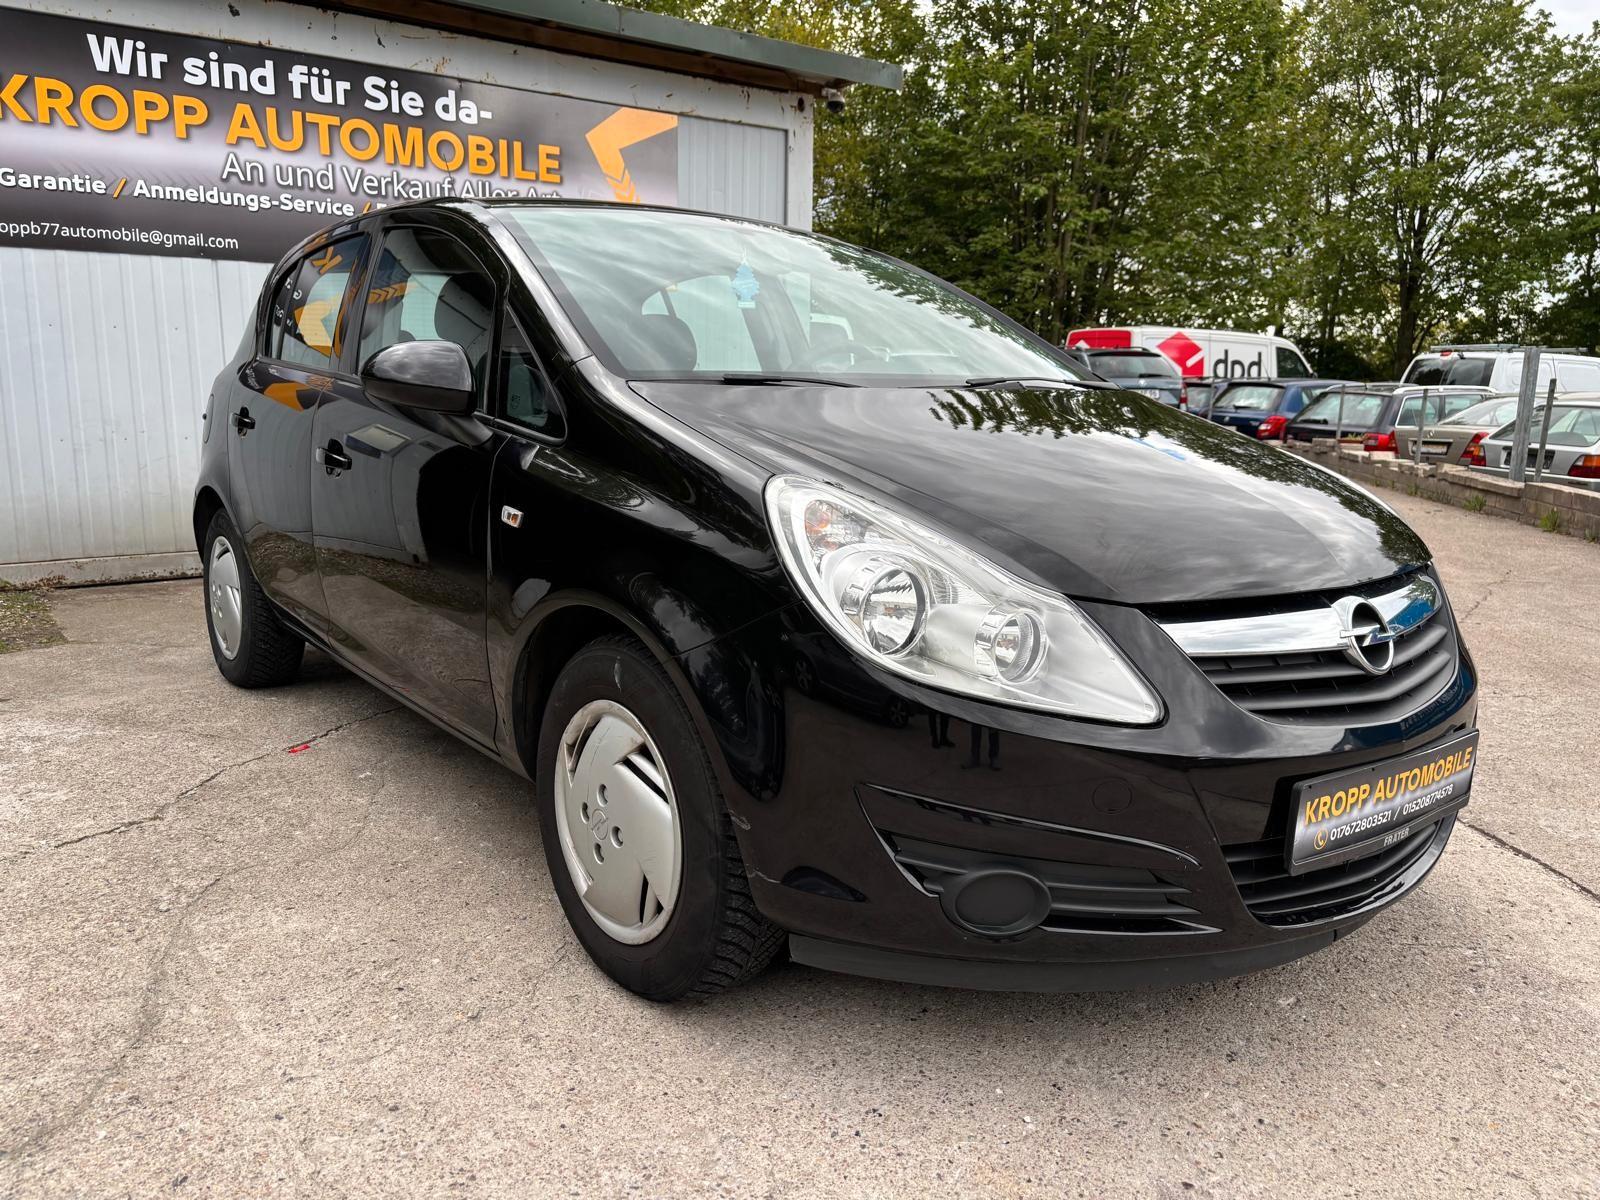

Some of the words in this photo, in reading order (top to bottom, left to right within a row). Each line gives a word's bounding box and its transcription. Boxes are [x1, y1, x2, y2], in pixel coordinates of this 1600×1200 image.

[86, 33, 168, 80] Wir
[183, 51, 276, 96] sind
[288, 65, 351, 106] für
[363, 76, 425, 116] Sie
[434, 90, 493, 124] da-
[0, 73, 209, 139] KROPP
[225, 103, 561, 184] AUTOMOBILE
[0, 167, 107, 194] Garantie
[133, 179, 355, 217] Anmeldungs-Service
[221, 152, 265, 184] An
[274, 162, 335, 191] und
[342, 166, 453, 198] Verkauf
[1305, 783, 1371, 825] KROPP
[1373, 746, 1473, 805] AUTOMOBILE
[1330, 810, 1392, 840] 017672803521
[1383, 827, 1410, 847] FRATER
